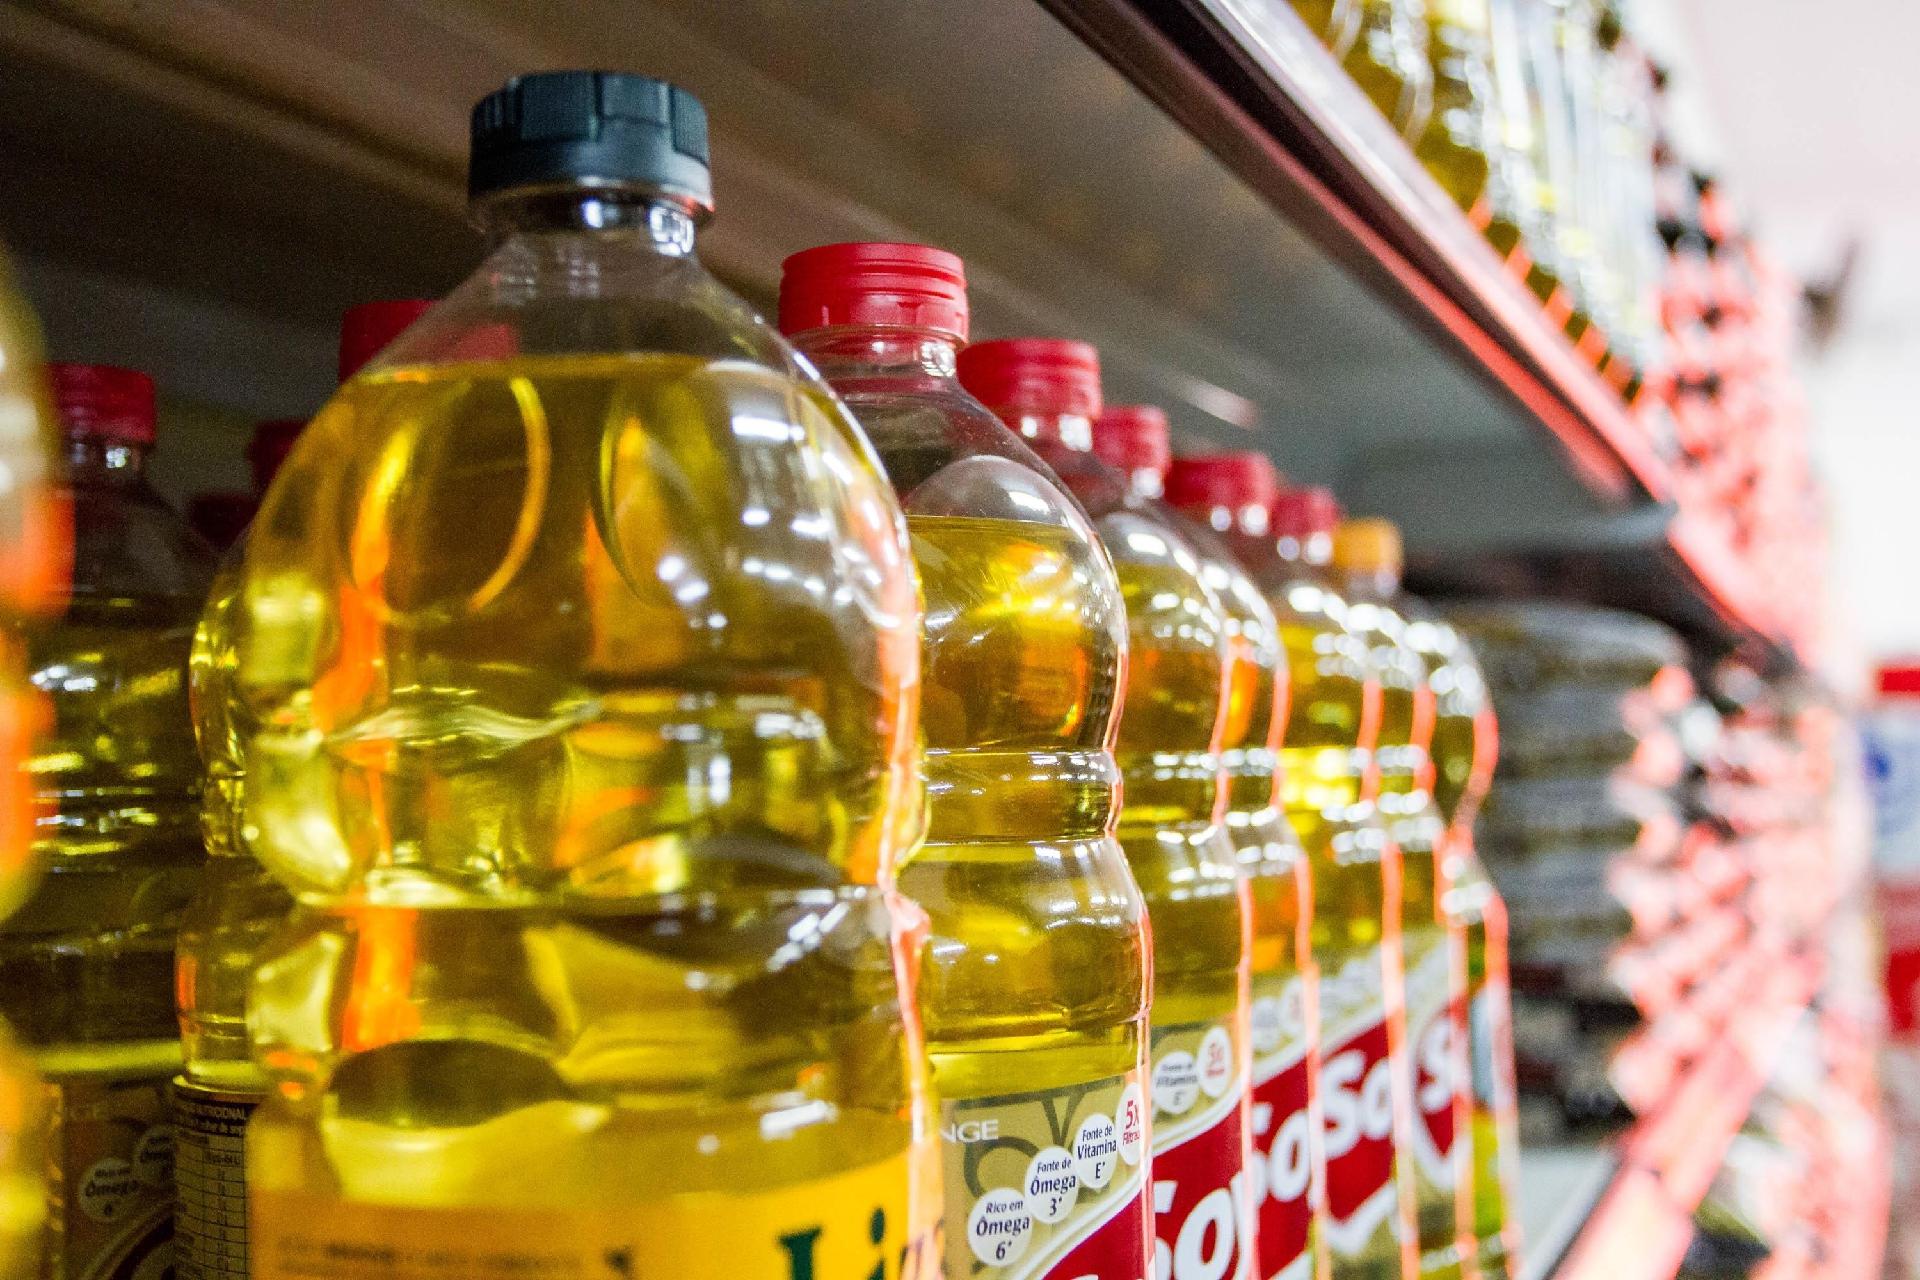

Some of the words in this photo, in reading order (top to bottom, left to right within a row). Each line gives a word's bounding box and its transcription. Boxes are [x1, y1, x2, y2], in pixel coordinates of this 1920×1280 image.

[1082, 1128, 1102, 1142] Fonte
[1104, 1125, 1113, 1136] de
[1077, 1139, 1117, 1160] Vitamina
[1037, 1160, 1060, 1174] Fonte
[1059, 1157, 1072, 1170] de
[1030, 1175, 1076, 1197] Ômega
[986, 1201, 1007, 1214] Rico
[1008, 1199, 1024, 1211] em
[976, 1216, 1030, 1237] Ômega
